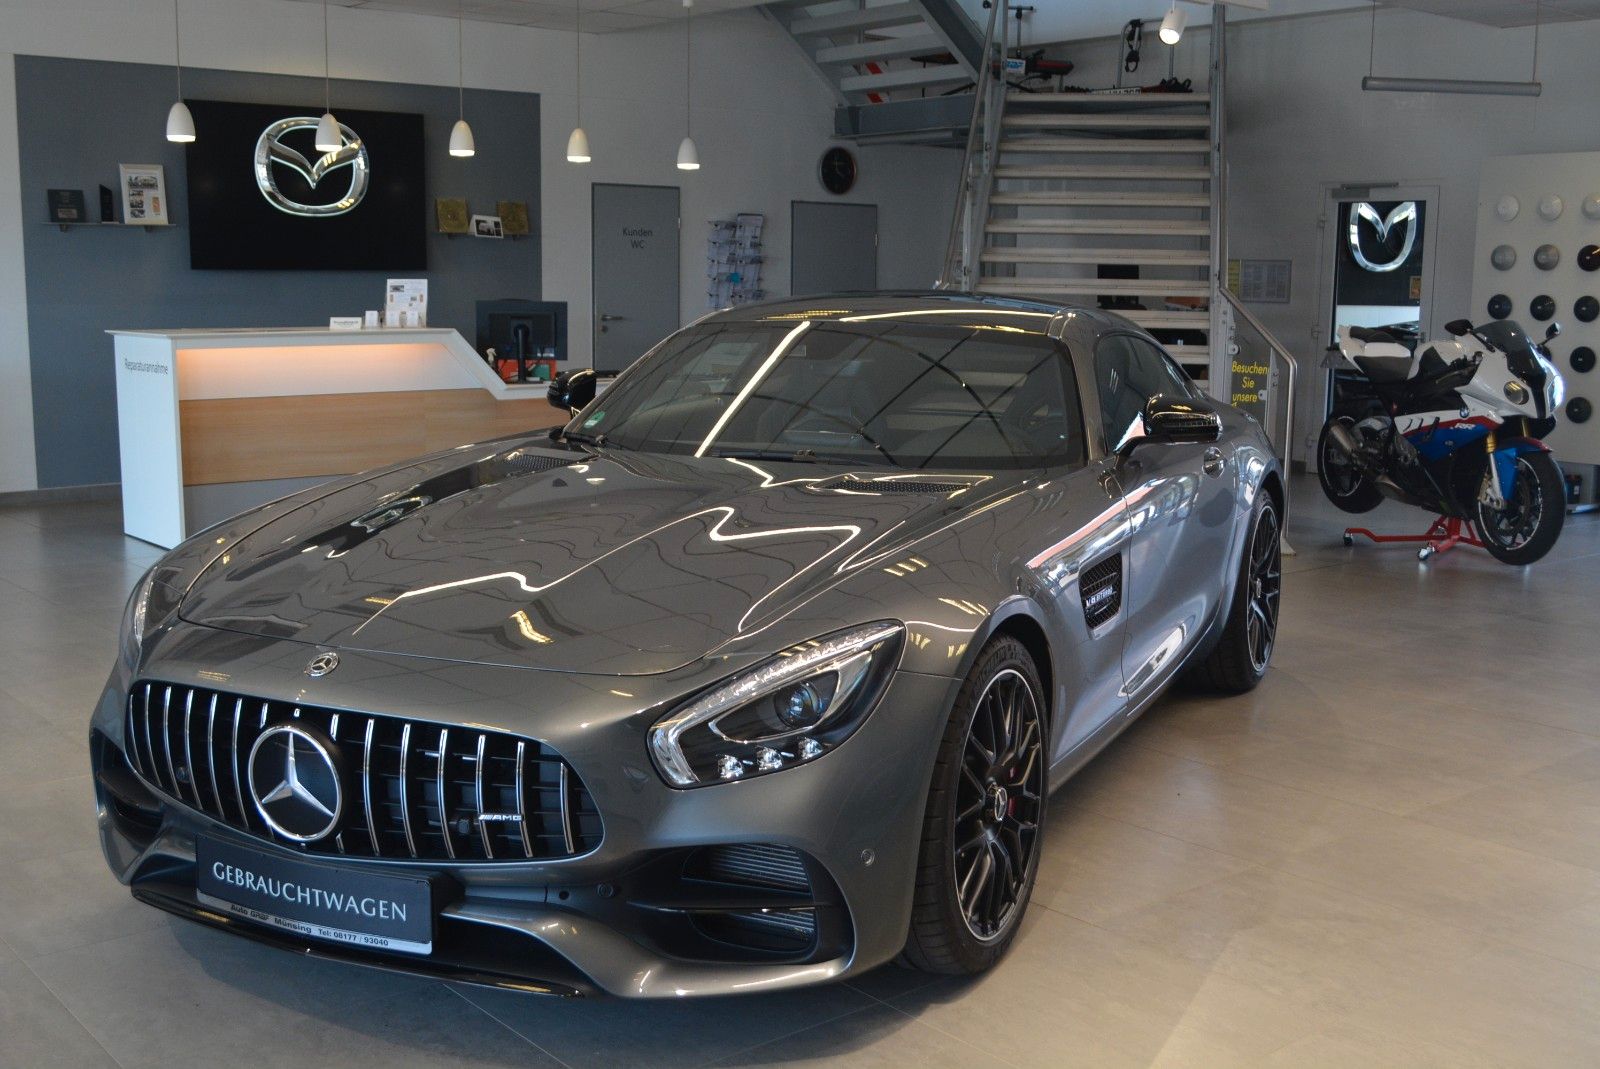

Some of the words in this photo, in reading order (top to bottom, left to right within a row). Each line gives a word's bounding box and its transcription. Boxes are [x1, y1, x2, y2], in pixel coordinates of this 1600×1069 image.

[622, 227, 653, 237] Kunden
[631, 239, 646, 249] WC
[1231, 361, 1268, 375] Besuchen
[1242, 376, 1255, 389] Sie
[1232, 393, 1258, 403] unsere
[213, 861, 407, 922] GEBRAUCHTWAGEN
[230, 904, 249, 916] Auto
[318, 928, 332, 938] Tel:
[333, 931, 357, 942] 08177
[364, 936, 389, 947] 93040
